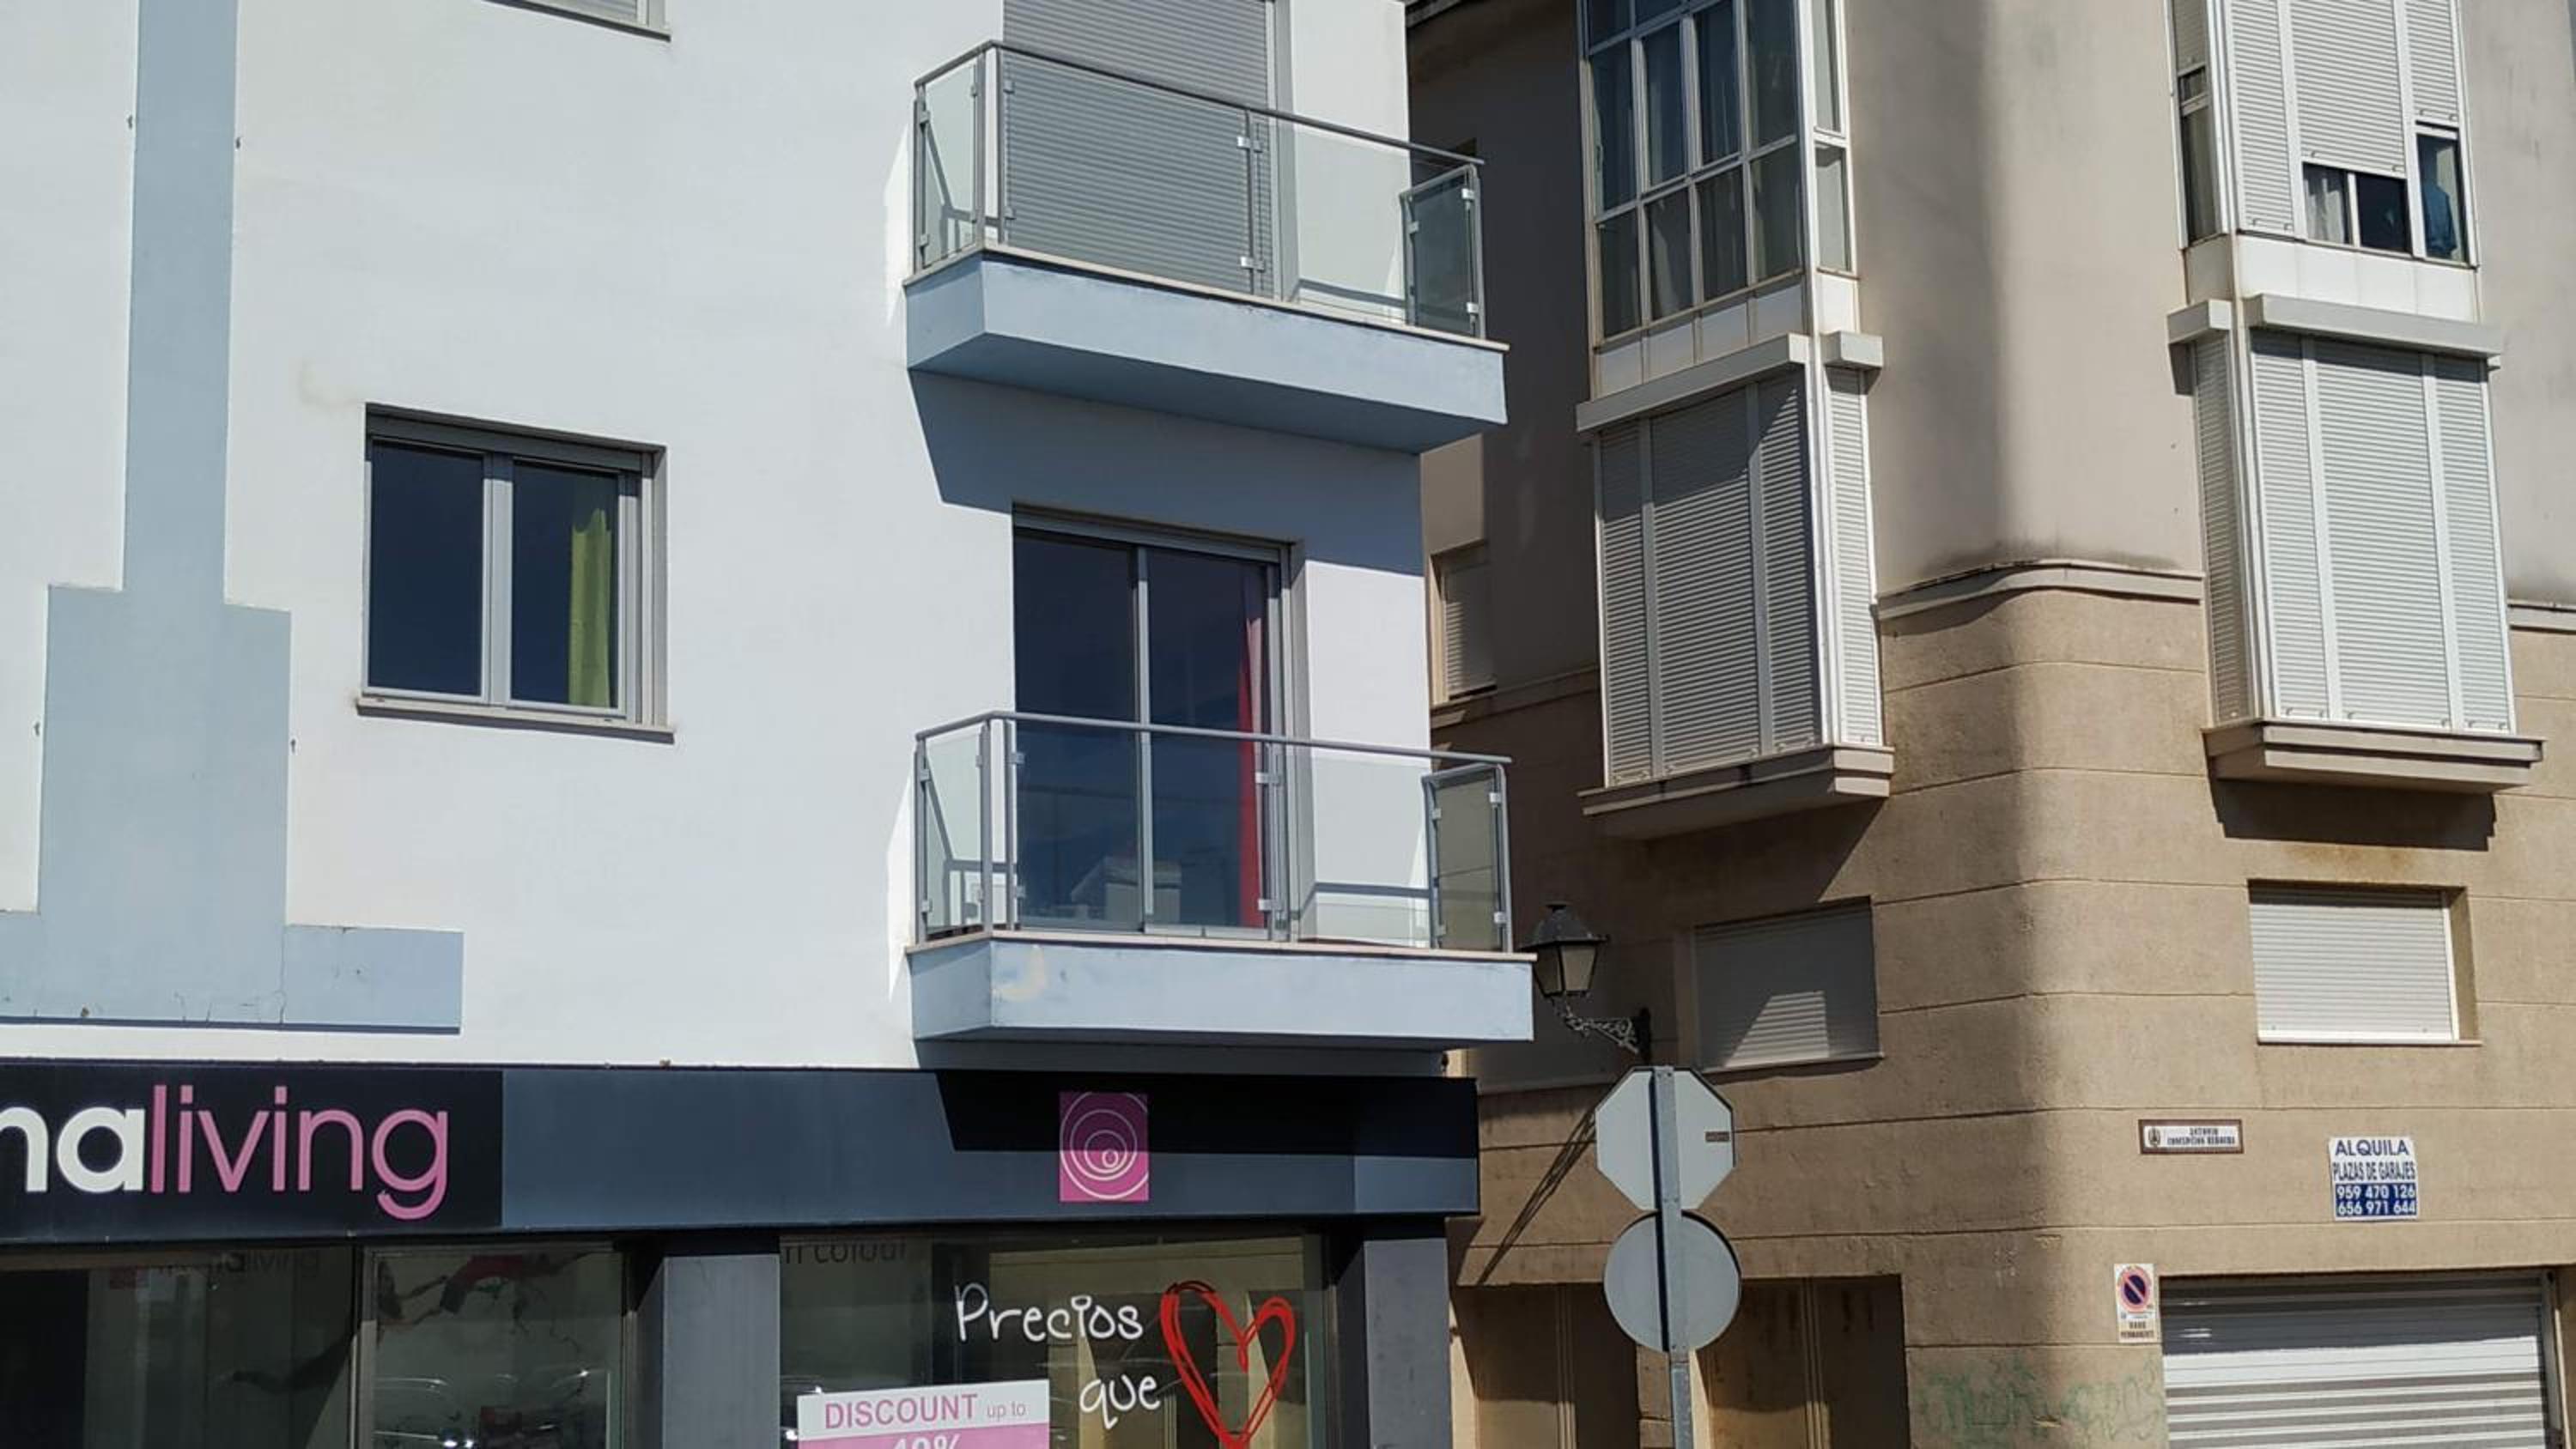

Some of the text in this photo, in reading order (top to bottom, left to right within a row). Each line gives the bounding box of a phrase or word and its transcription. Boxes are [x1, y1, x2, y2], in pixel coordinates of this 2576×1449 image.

[2335, 1139, 2409, 1156] ALQUILA
[2332, 1161, 2415, 1181] PLAZAS DE GARAJES
[2336, 1185, 2361, 1199] 959
[2392, 1185, 2415, 1199] 126
[2338, 1200, 2416, 1216] 656 971 644
[955, 1282, 1144, 1343] Precios
[824, 1393, 1027, 1429] DISCOUNT up to
[1079, 1373, 1160, 1430] que
